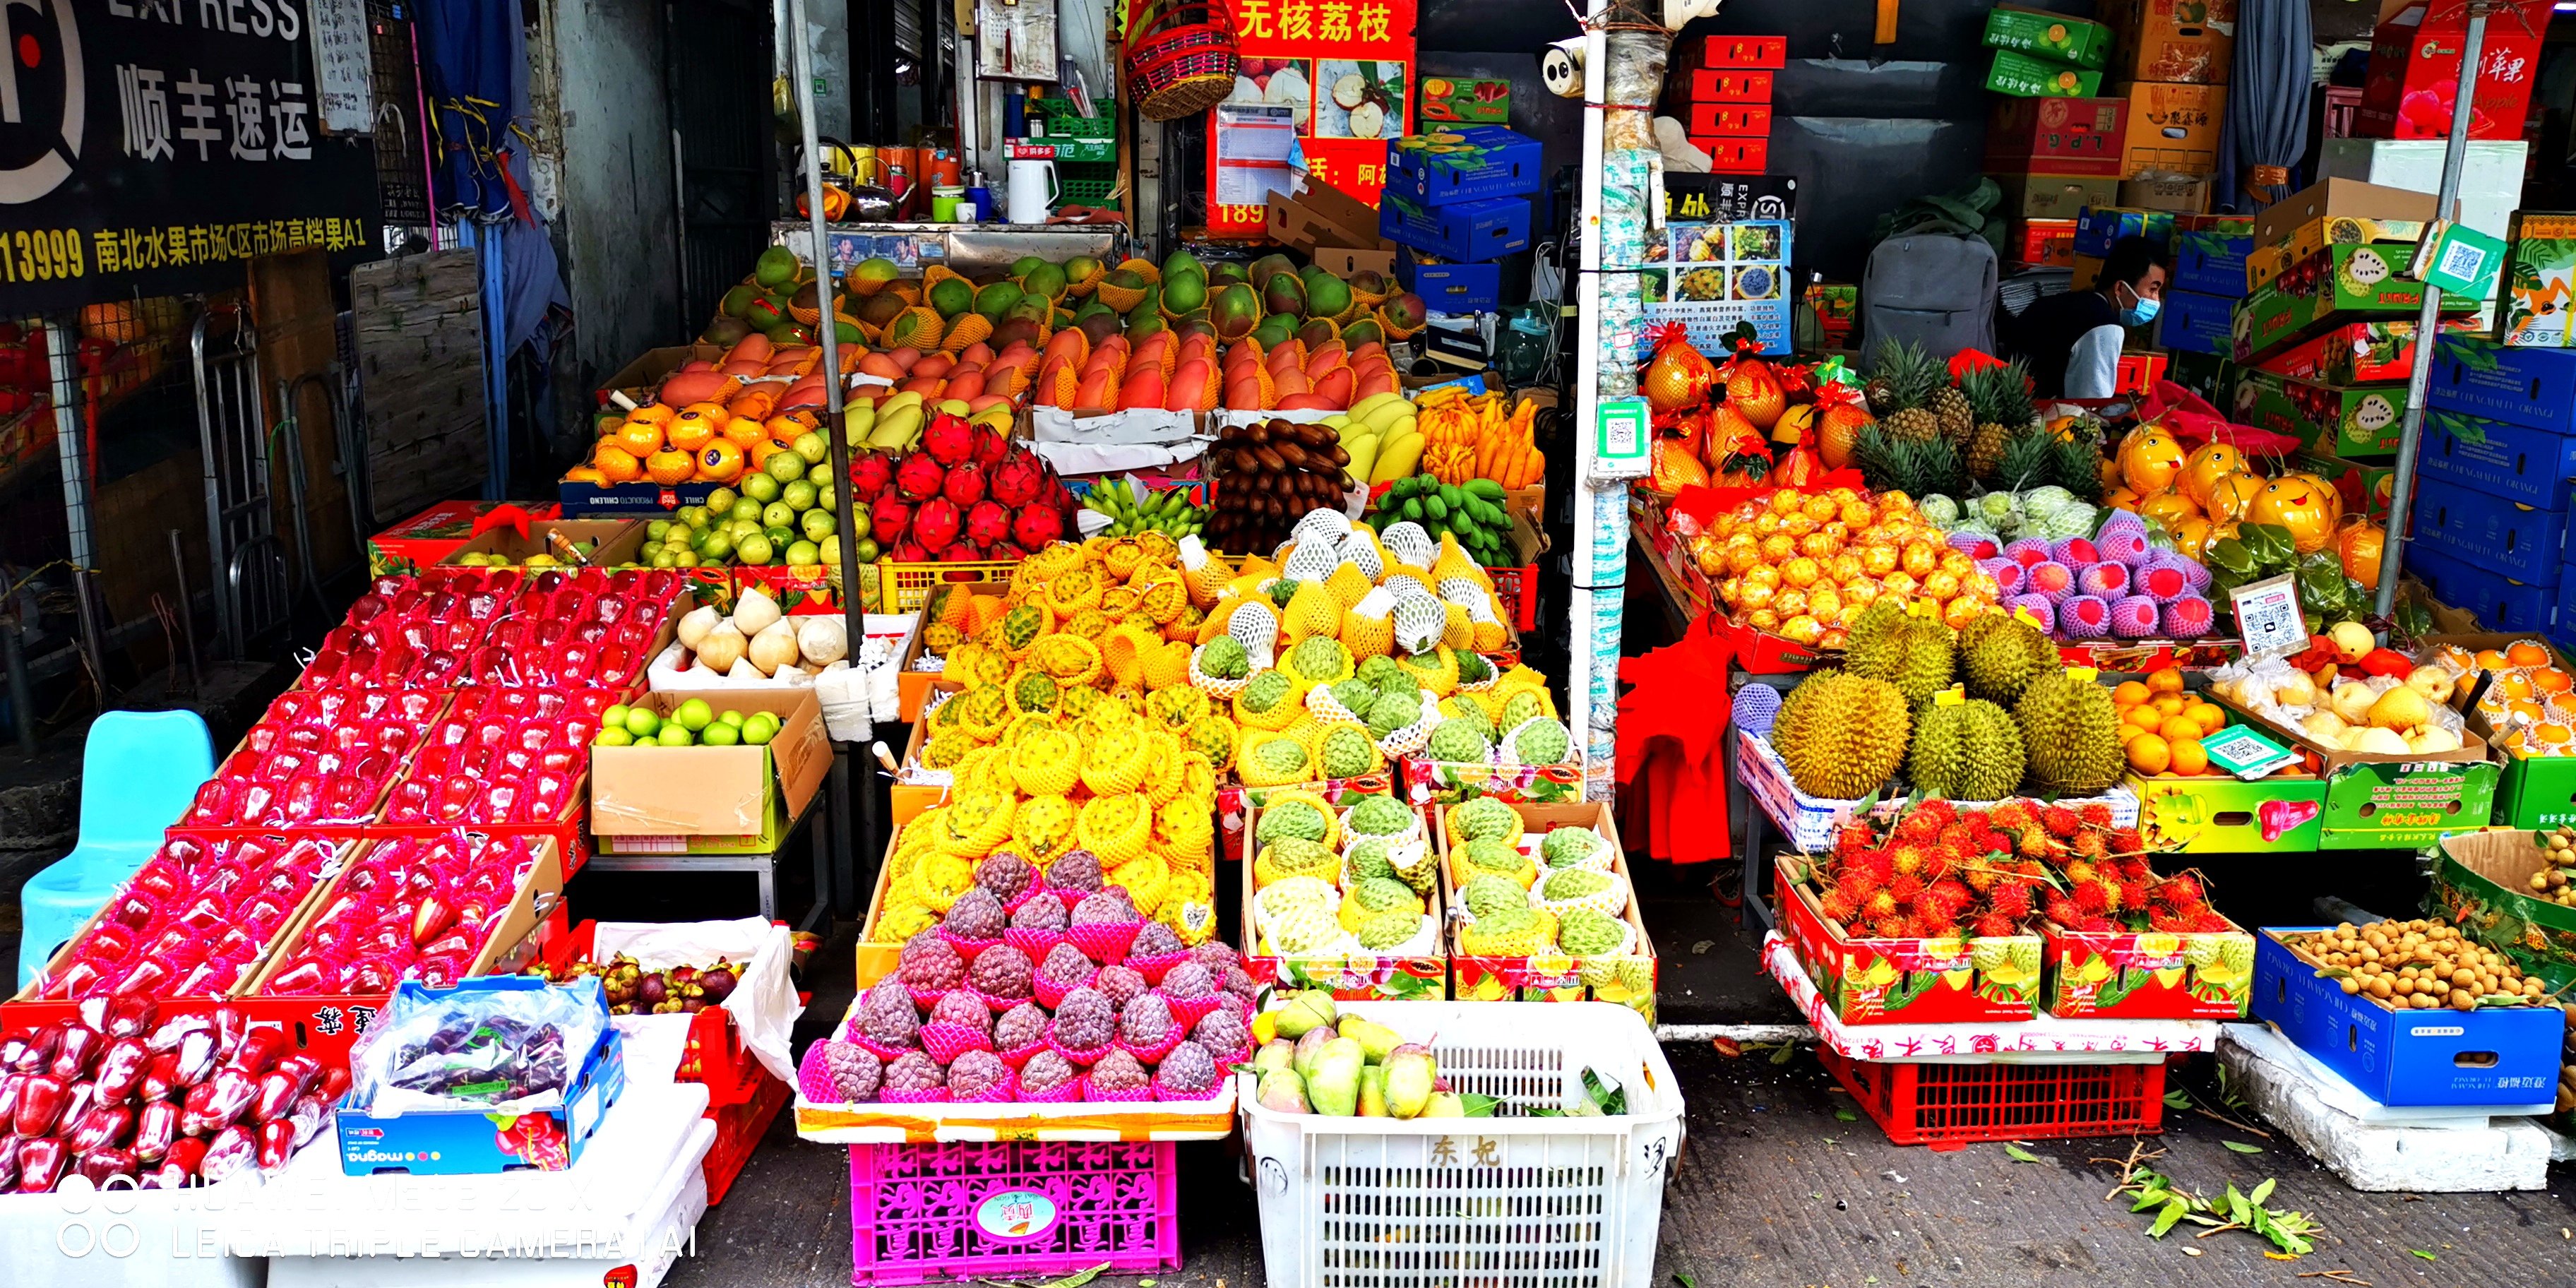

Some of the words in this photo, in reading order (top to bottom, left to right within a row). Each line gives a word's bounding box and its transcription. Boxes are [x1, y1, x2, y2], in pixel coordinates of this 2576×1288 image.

[1239, 1, 1391, 42] 无核荔枝
[116, 64, 311, 162] 顺丰速运
[2473, 93, 2518, 113] Apple
[1029, 147, 1051, 155] 拼多多
[93, 217, 366, 274] 南北水果市场C区市场高档果A1
[2498, 1076, 2546, 1089] 澄迈福橙
[347, 1150, 403, 1162] magna
[1431, 1135, 1501, 1168] 东妃
[1001, 1202, 1034, 1222] 西贡
